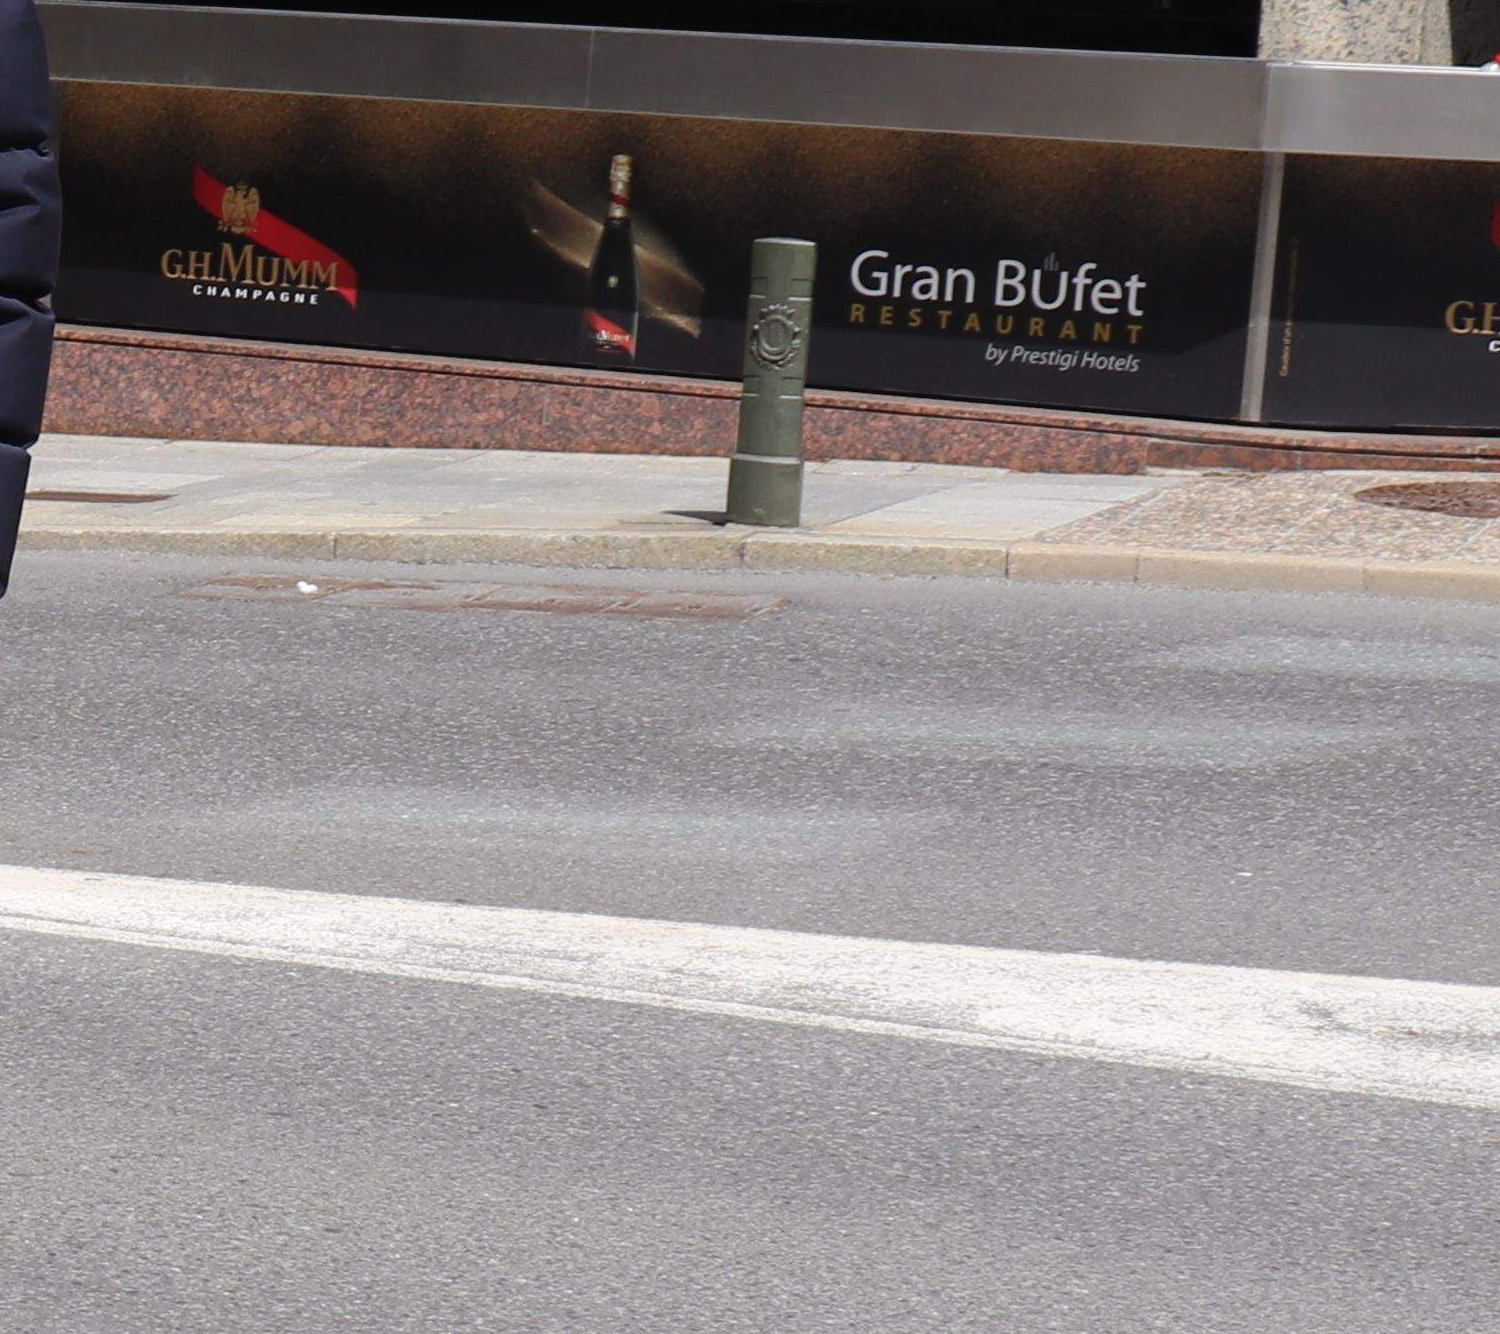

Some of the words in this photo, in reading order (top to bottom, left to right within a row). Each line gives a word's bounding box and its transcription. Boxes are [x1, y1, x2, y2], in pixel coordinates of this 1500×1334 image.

[192, 284, 320, 306] CHAMPAGNE
[850, 249, 976, 304] Gran
[850, 302, 1143, 345] RESTAURANT
[984, 342, 1007, 366] by
[1009, 345, 1079, 371] Prestigi
[1080, 351, 1141, 373] Hotels
